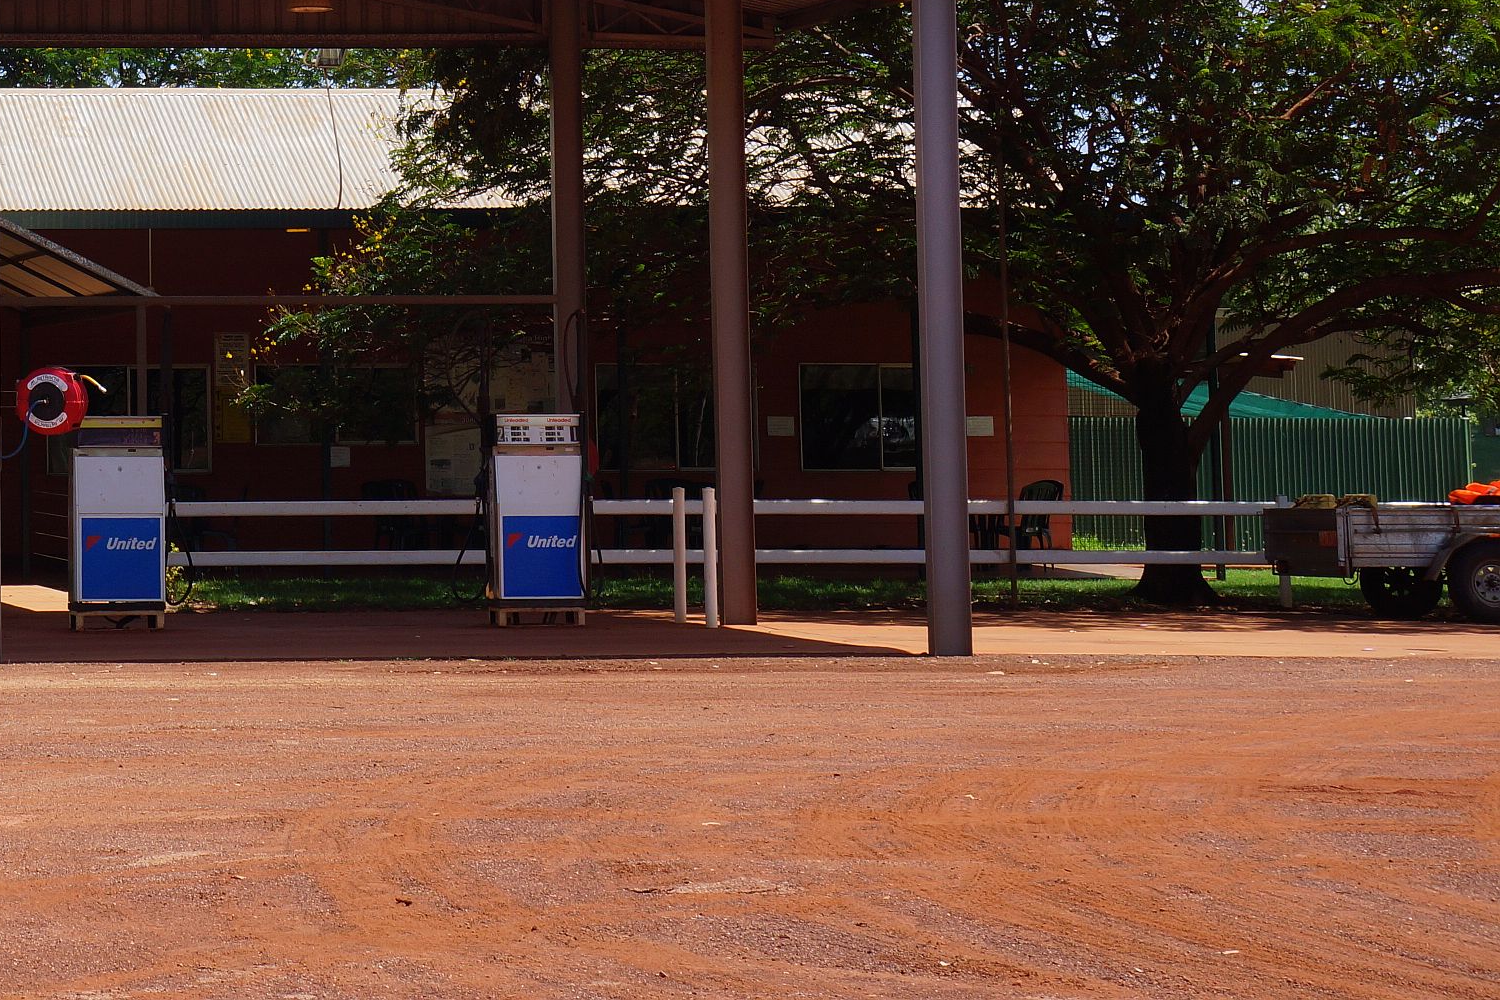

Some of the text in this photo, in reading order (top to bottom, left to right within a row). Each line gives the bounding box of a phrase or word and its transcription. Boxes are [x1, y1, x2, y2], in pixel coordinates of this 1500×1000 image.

[497, 427, 504, 441] 2
[106, 537, 157, 550] United
[527, 535, 577, 549] United
